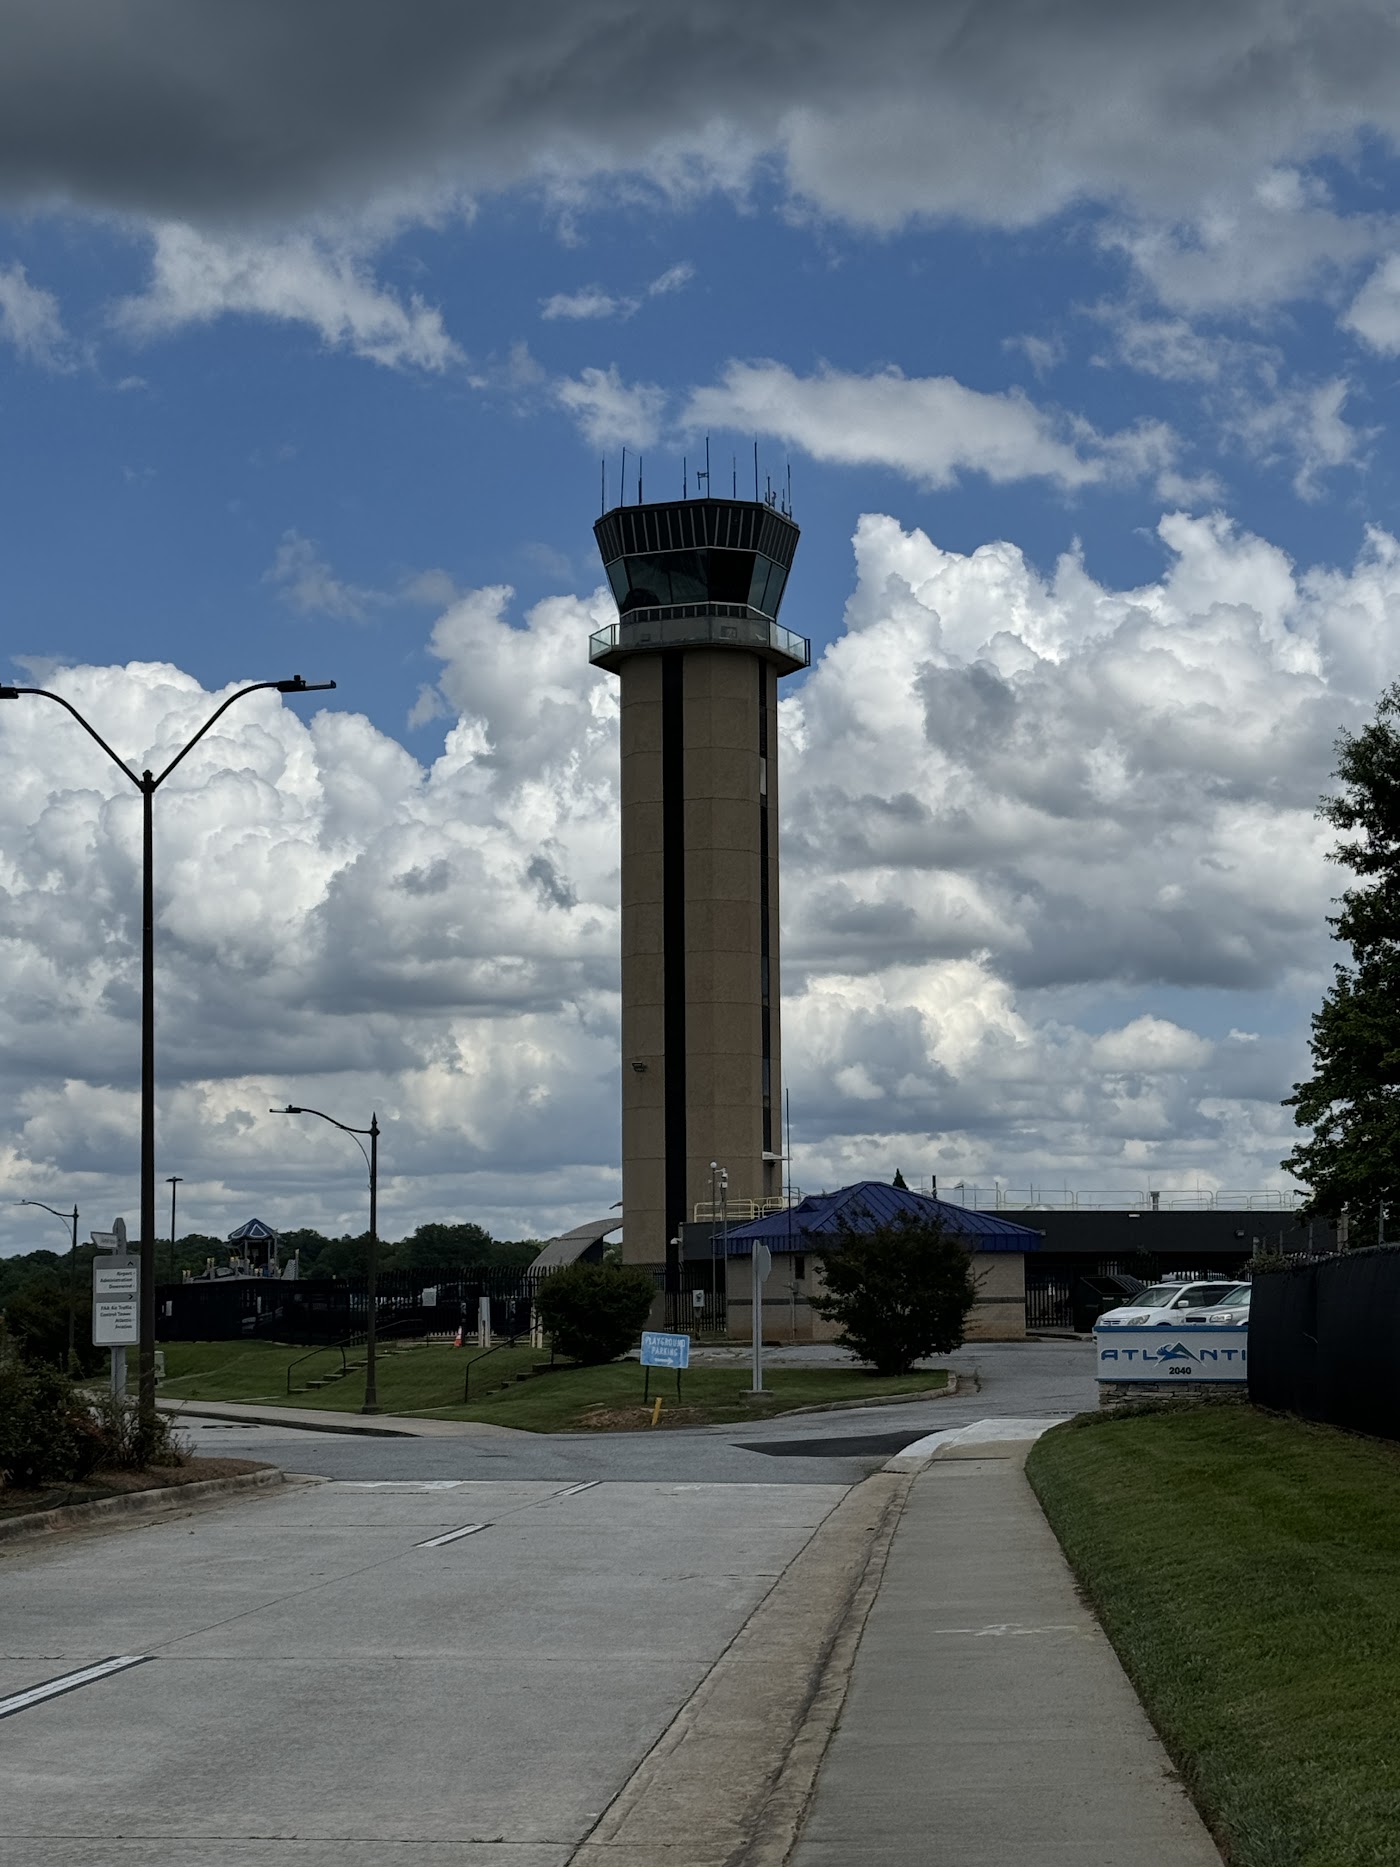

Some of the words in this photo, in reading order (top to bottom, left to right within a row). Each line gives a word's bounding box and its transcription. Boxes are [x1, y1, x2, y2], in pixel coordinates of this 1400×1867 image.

[644, 1336, 686, 1348] PLAYGROUND
[651, 1346, 678, 1357] PARKING
[1101, 1341, 1246, 1364] ATLANTI
[1168, 1366, 1192, 1375] 2040
